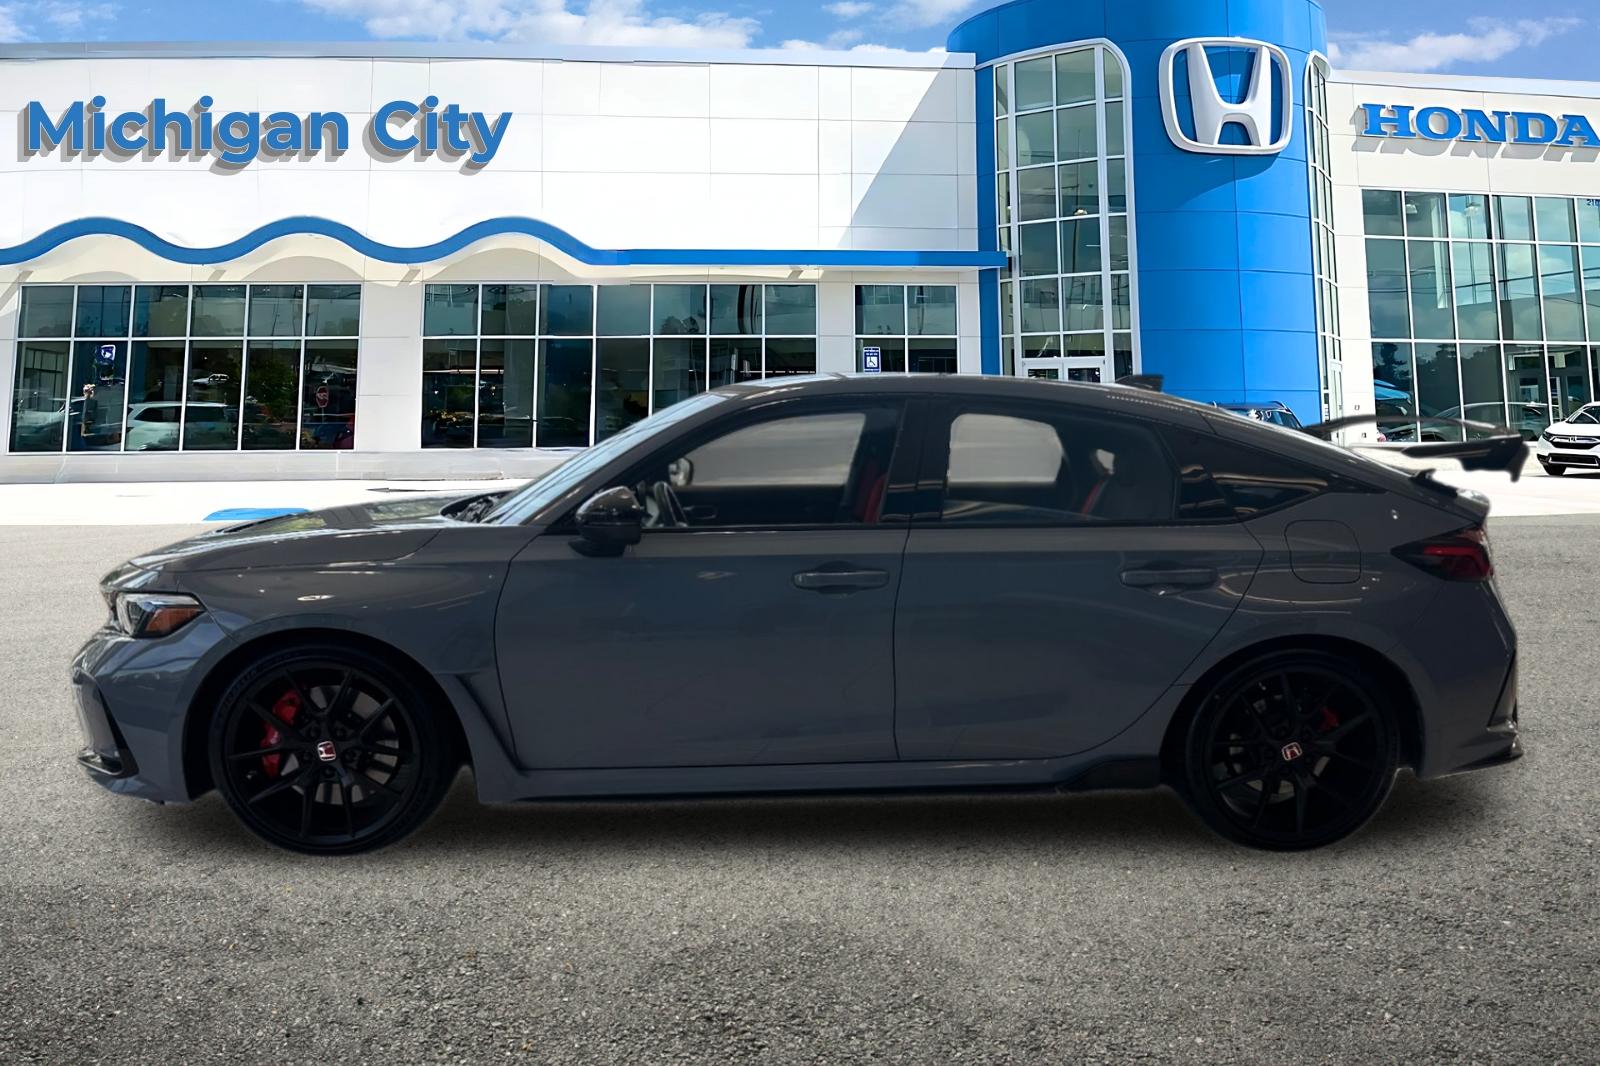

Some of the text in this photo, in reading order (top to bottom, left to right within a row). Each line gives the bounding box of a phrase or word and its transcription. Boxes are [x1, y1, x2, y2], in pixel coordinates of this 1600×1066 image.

[29, 95, 513, 163] Michigan City
[1362, 103, 1600, 147] HONDA
